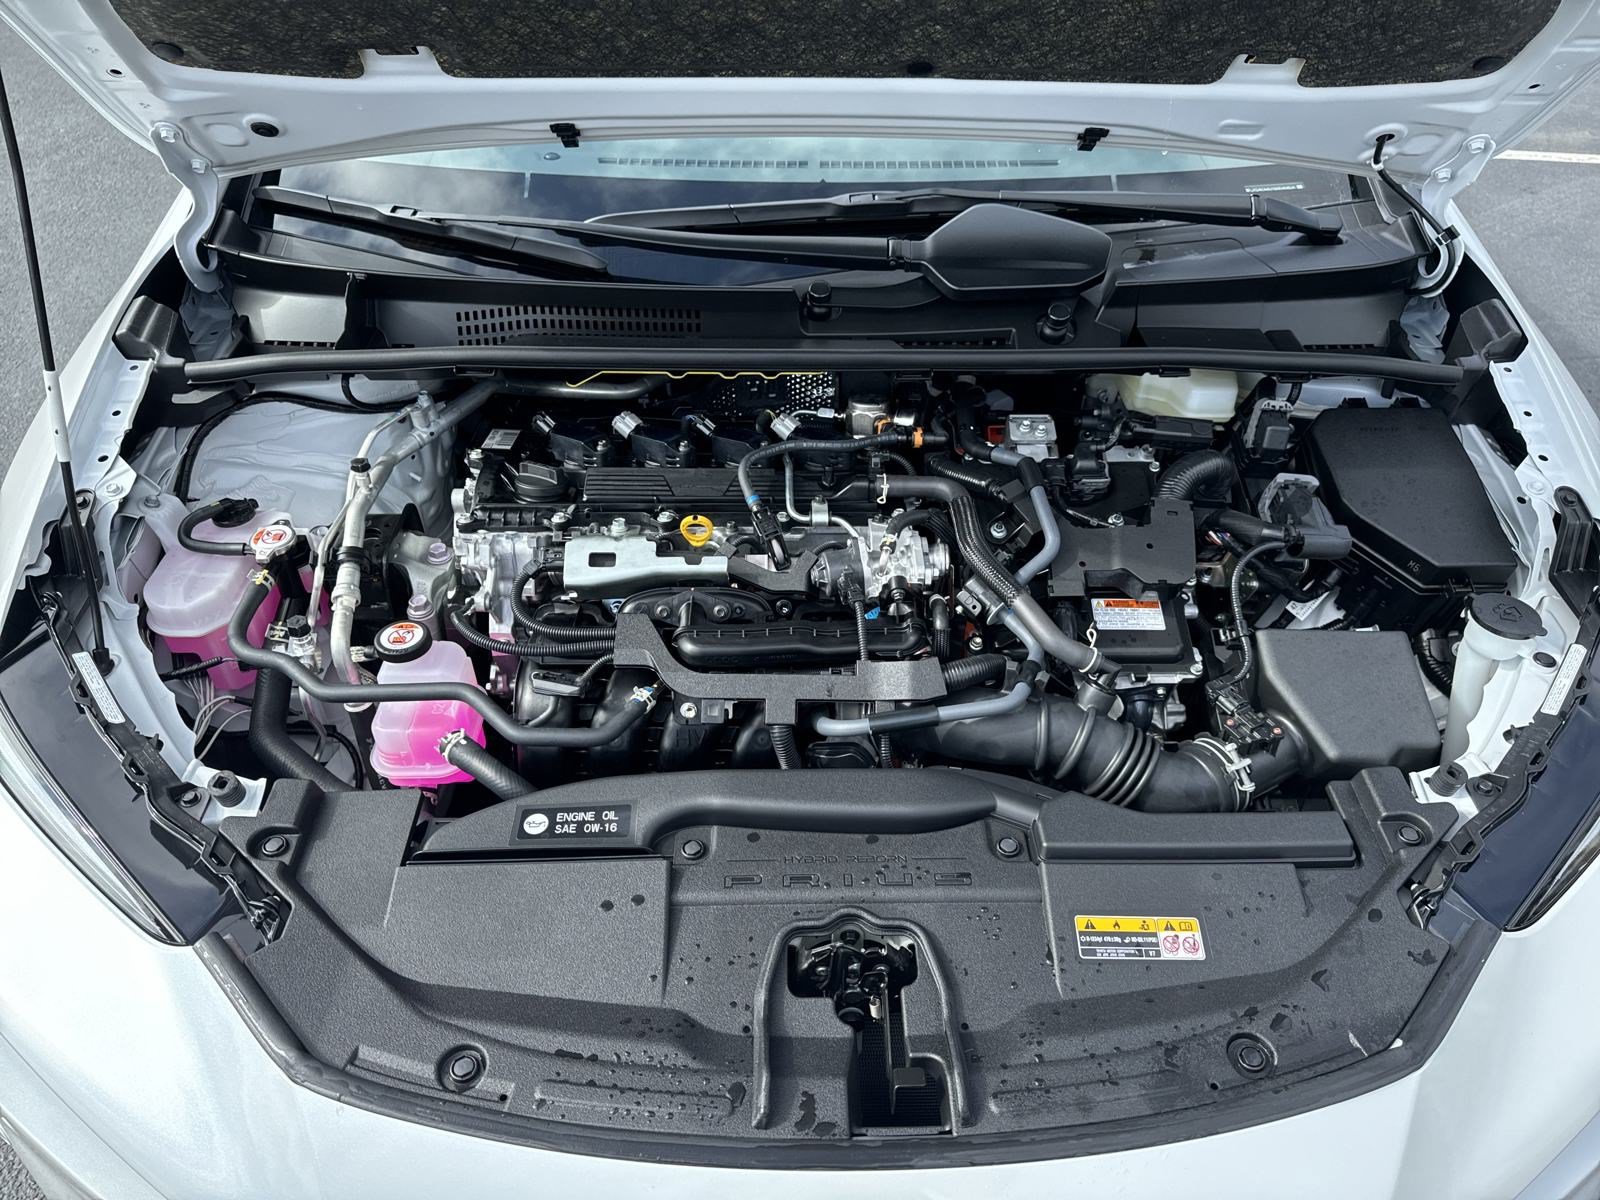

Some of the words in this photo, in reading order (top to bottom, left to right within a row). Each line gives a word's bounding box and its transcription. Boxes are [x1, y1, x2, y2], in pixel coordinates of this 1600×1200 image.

[556, 811, 596, 822] ENGINE
[602, 810, 619, 821] OIL
[554, 823, 577, 834] SAE
[583, 822, 618, 833] 0W-16
[783, 855, 838, 865] HYBRID
[846, 854, 908, 864] REBORN
[723, 872, 973, 889] PRIUS
